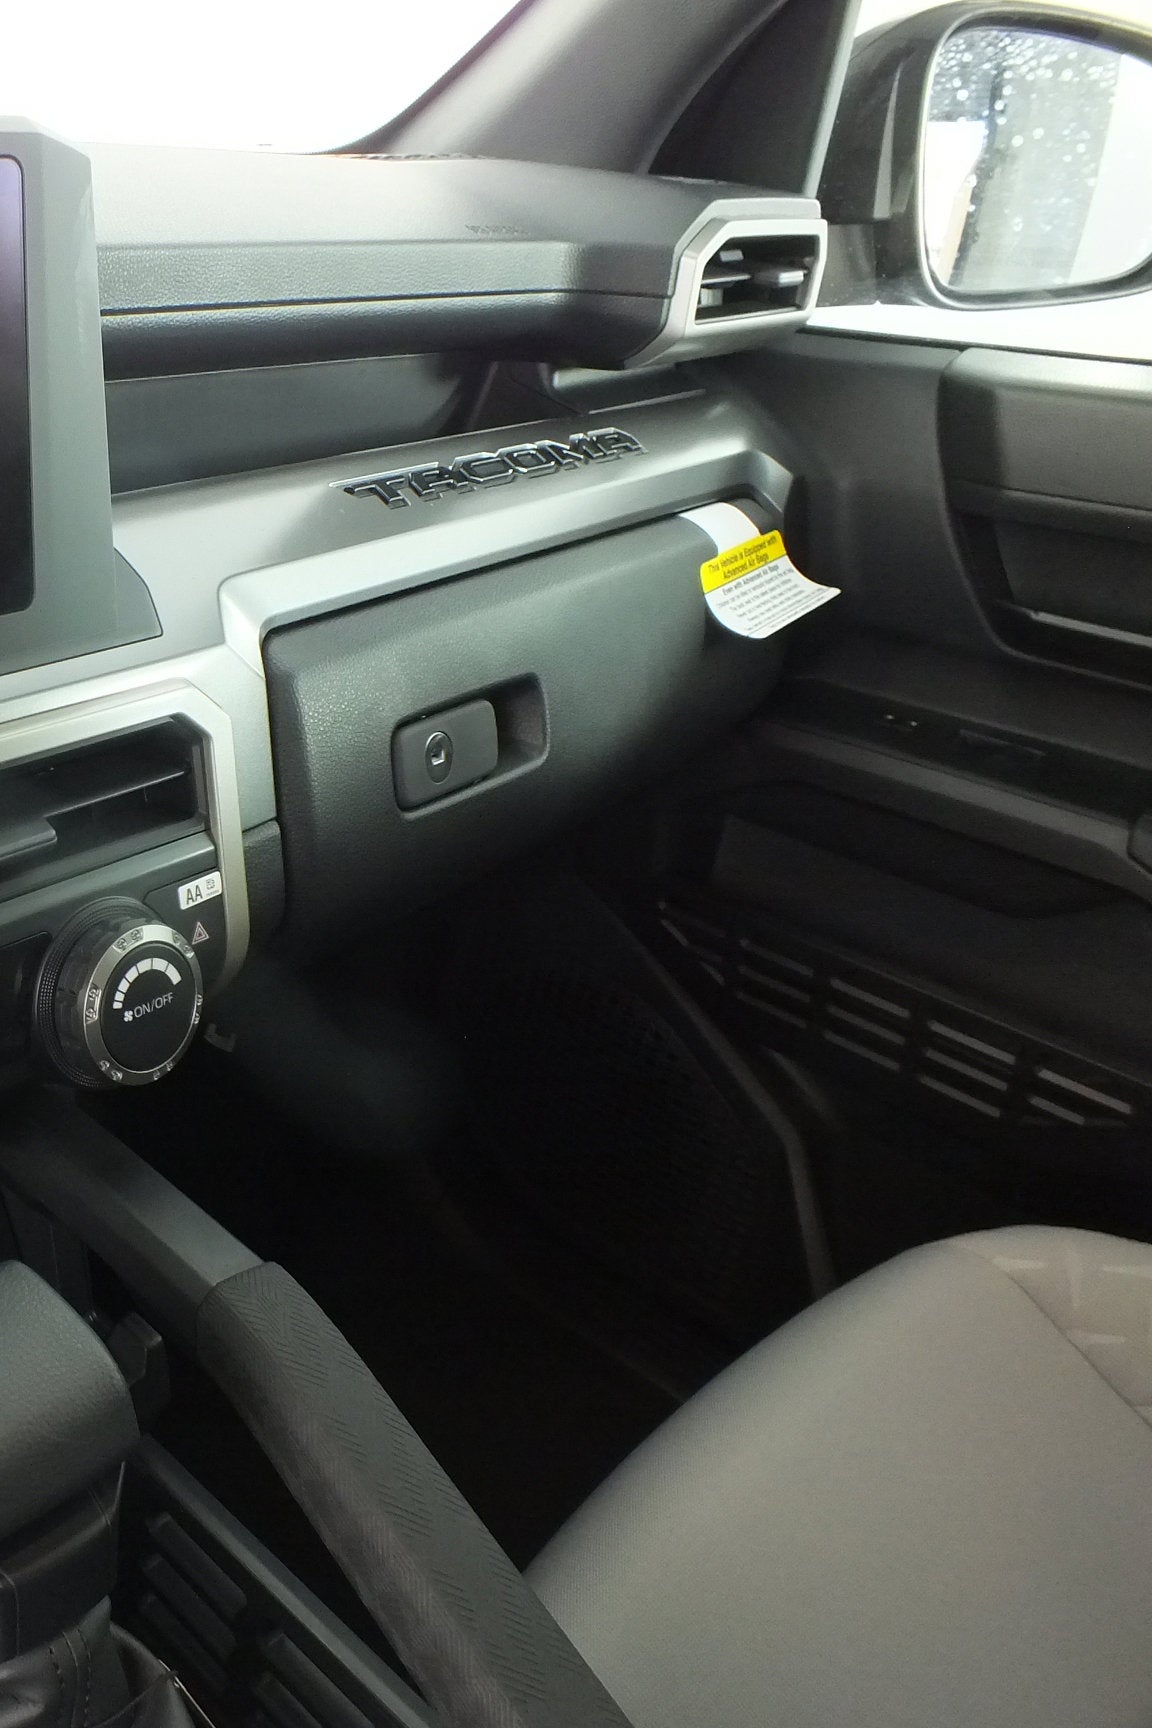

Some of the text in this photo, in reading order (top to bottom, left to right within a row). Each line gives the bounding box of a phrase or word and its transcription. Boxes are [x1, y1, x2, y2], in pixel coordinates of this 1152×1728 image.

[329, 427, 647, 508] TACOMA
[720, 555, 738, 569] Vehicle
[744, 543, 767, 558] Equipped
[767, 536, 777, 547] with
[723, 553, 769, 580] Advanced Air Bags
[743, 572, 761, 585] Advanced
[186, 884, 204, 906] AA
[134, 992, 174, 1019] ON/OFF
